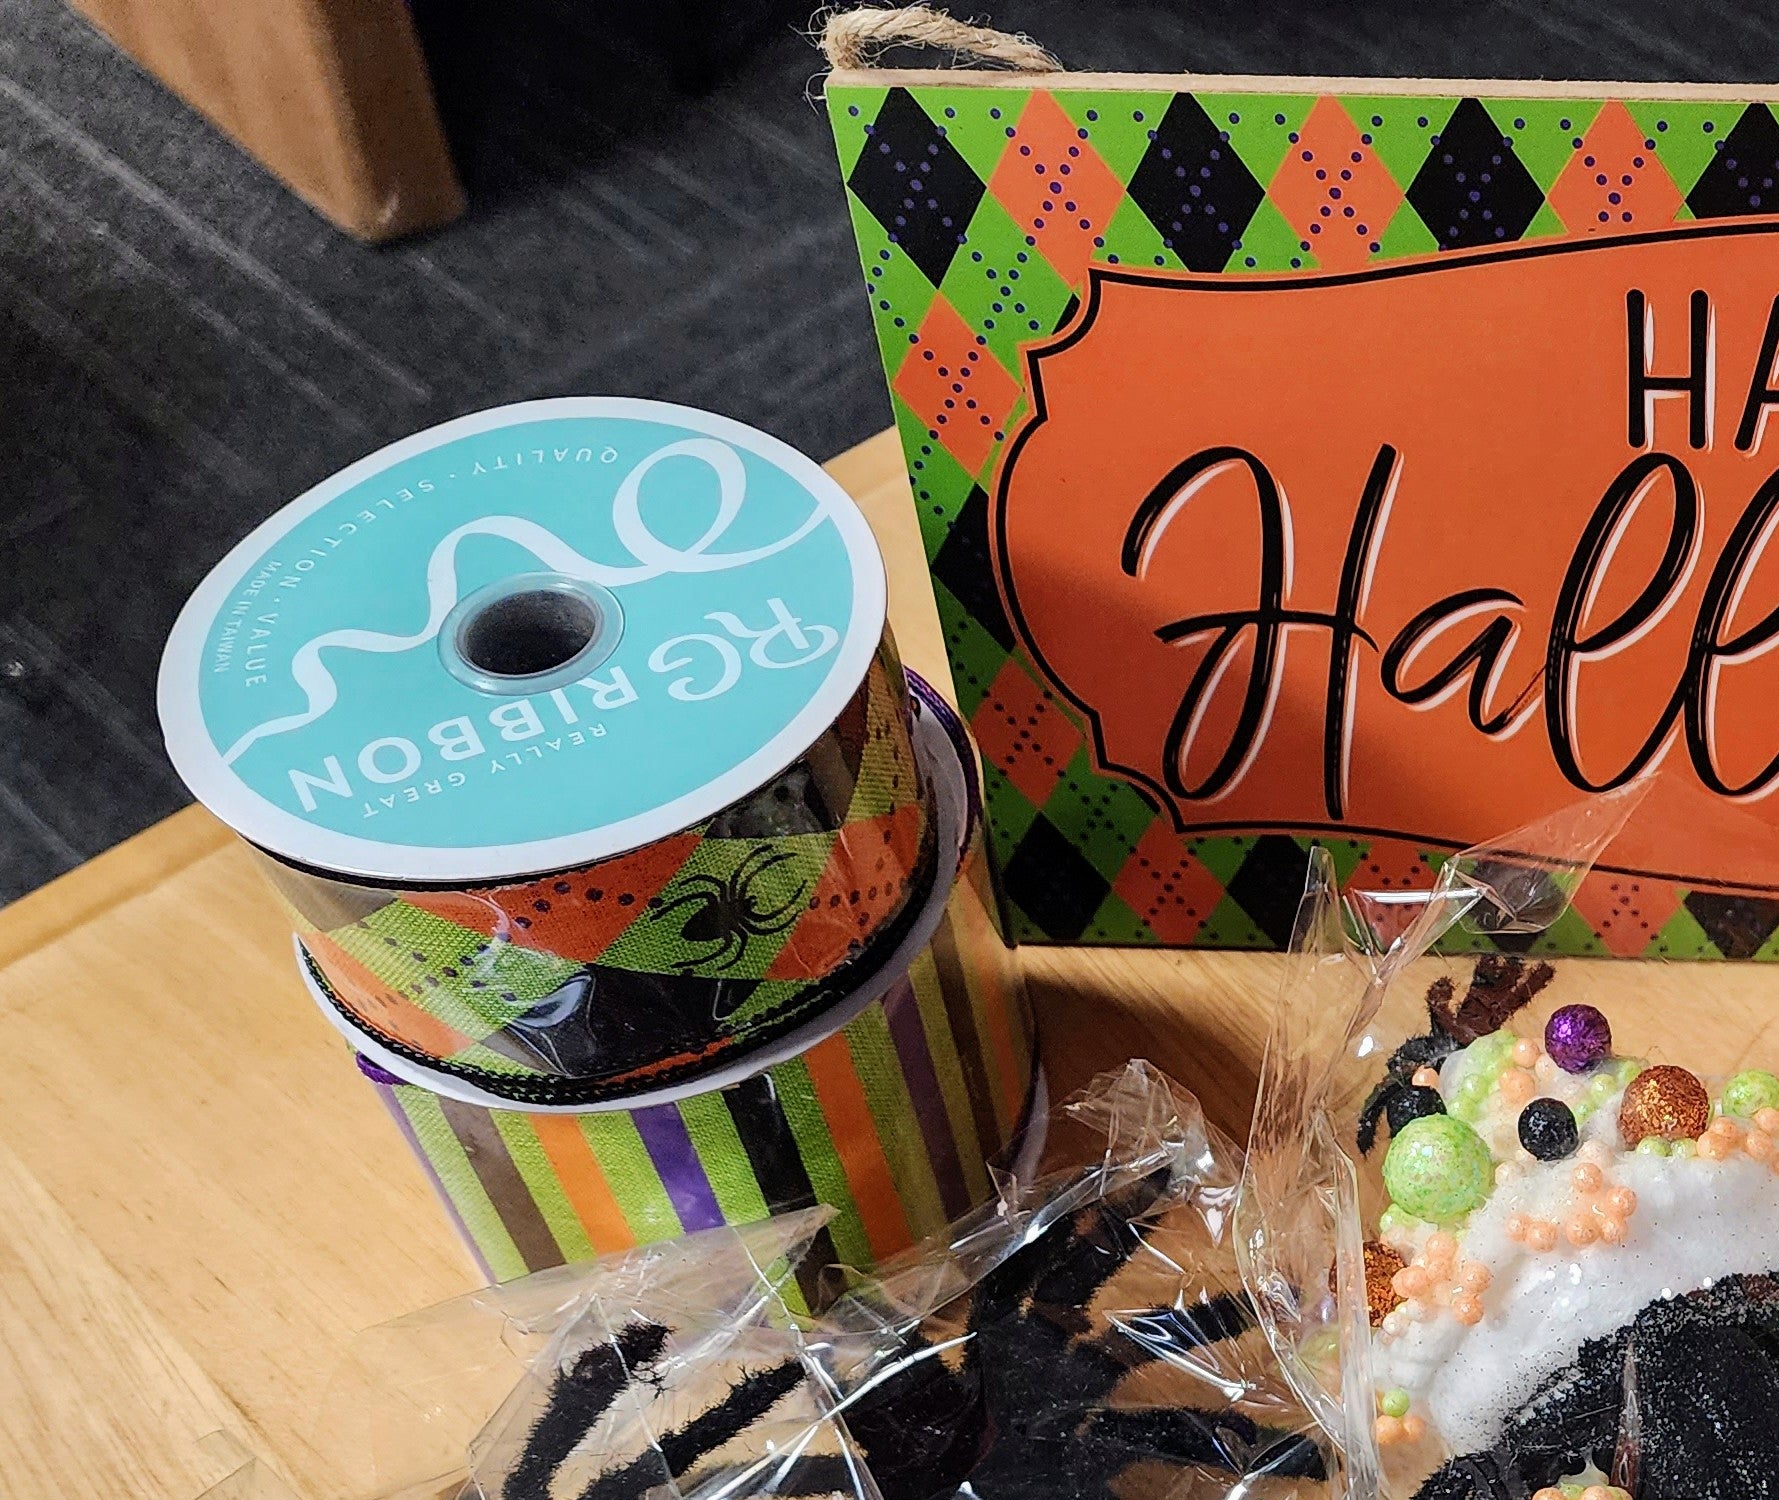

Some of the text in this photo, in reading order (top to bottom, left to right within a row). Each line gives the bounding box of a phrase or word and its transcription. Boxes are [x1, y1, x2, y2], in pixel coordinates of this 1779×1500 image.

[214, 560, 282, 673] MADE IN TAIWAN
[244, 446, 618, 688] QUALITY SELECTION VALUE
[646, 597, 839, 702] RG
[287, 664, 640, 813] RIBBON
[361, 722, 607, 818] REALLY GREAT
